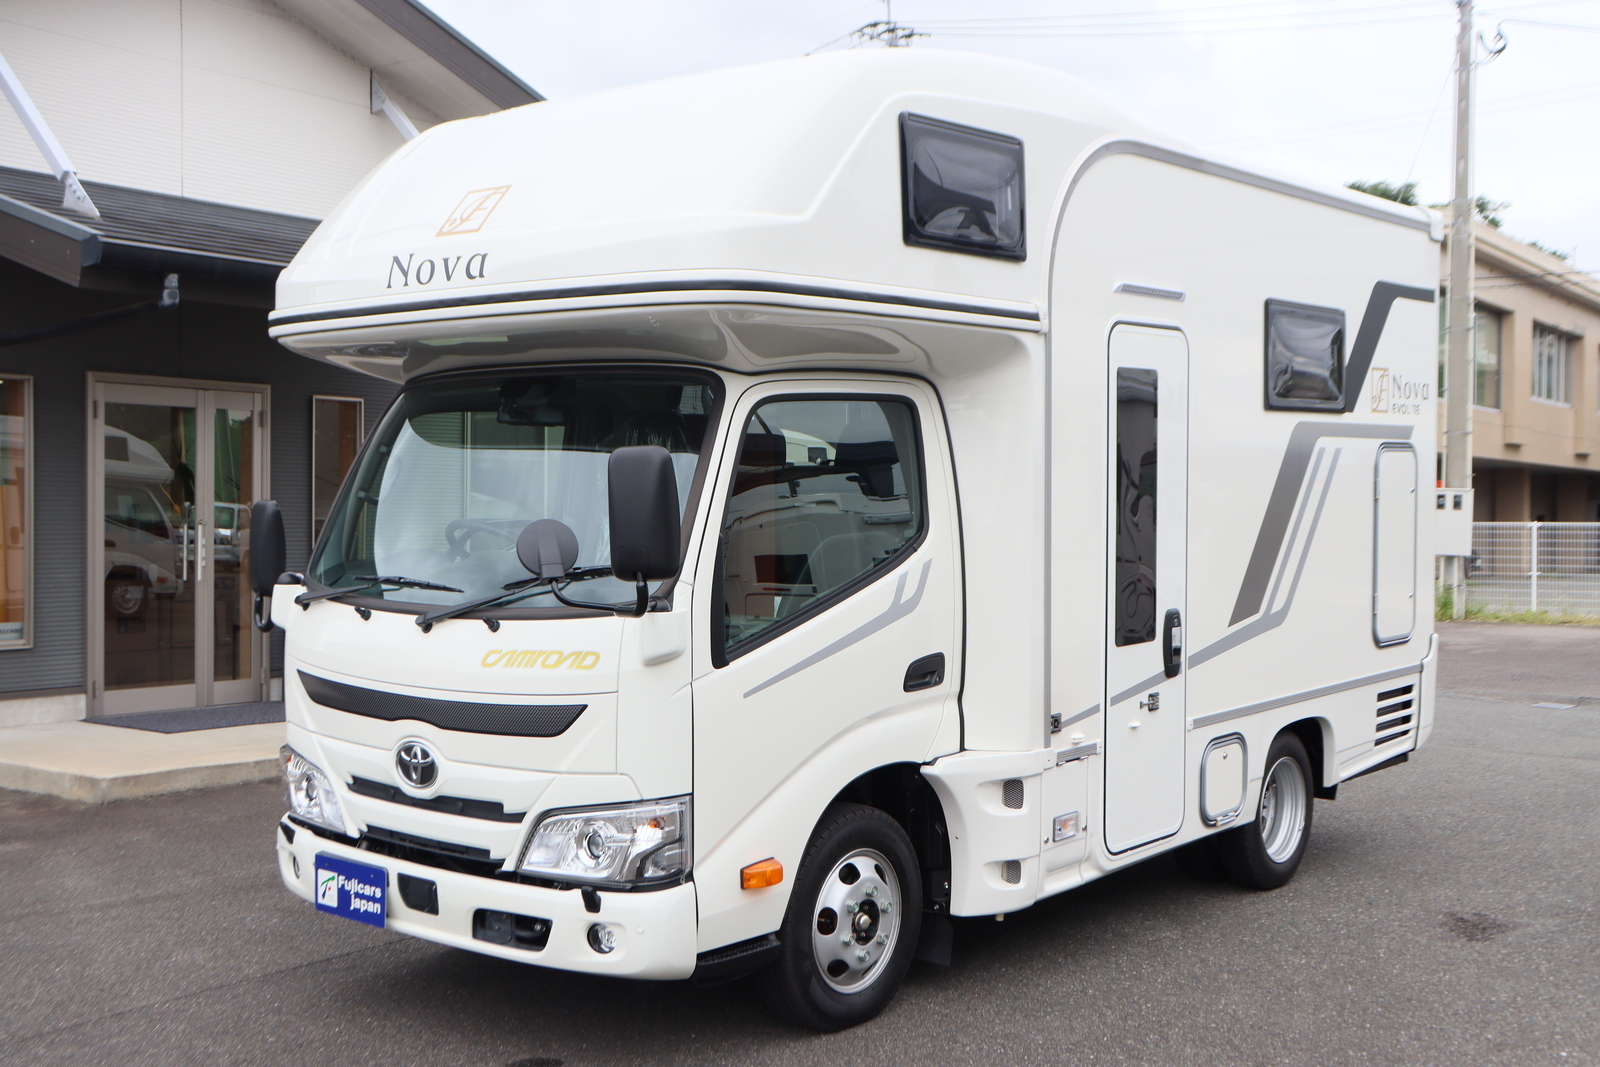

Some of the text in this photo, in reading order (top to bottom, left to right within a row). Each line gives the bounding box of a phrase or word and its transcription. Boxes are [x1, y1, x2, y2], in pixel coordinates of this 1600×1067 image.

[386, 252, 489, 289] Nova
[1392, 374, 1430, 401] Nova
[1392, 402, 1421, 415] EVOLTE
[338, 874, 382, 899] Fujicars
